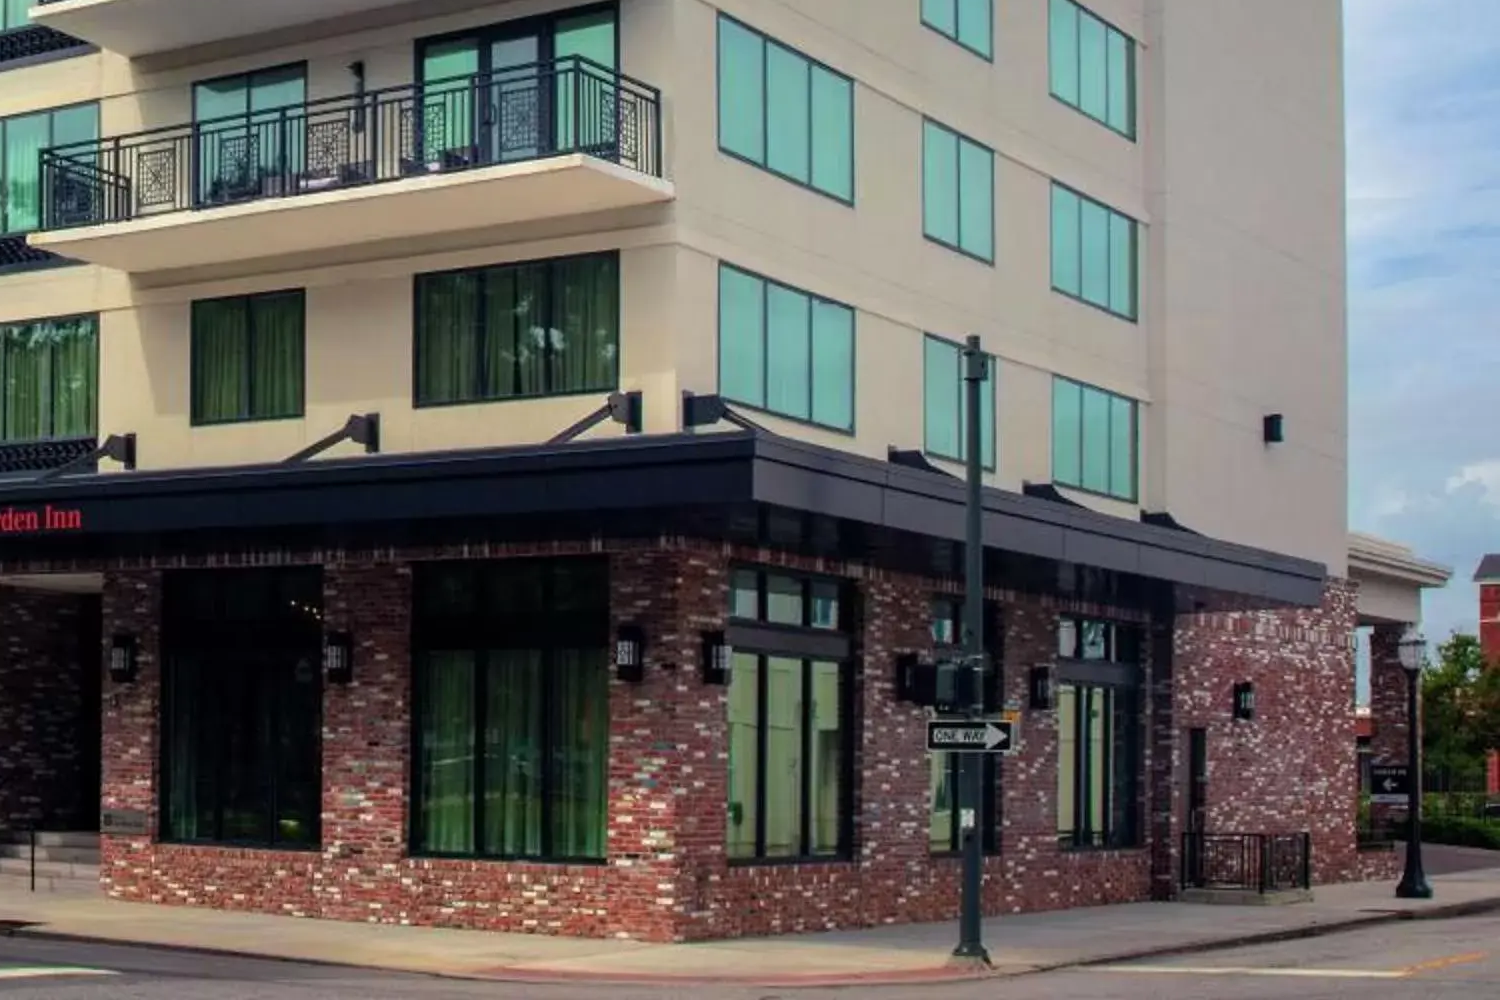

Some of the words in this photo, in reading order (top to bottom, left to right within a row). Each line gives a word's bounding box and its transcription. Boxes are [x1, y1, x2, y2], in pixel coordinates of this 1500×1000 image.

[45, 505, 82, 529] Inn
[934, 729, 957, 742] ONE
[962, 729, 985, 742] WAY
